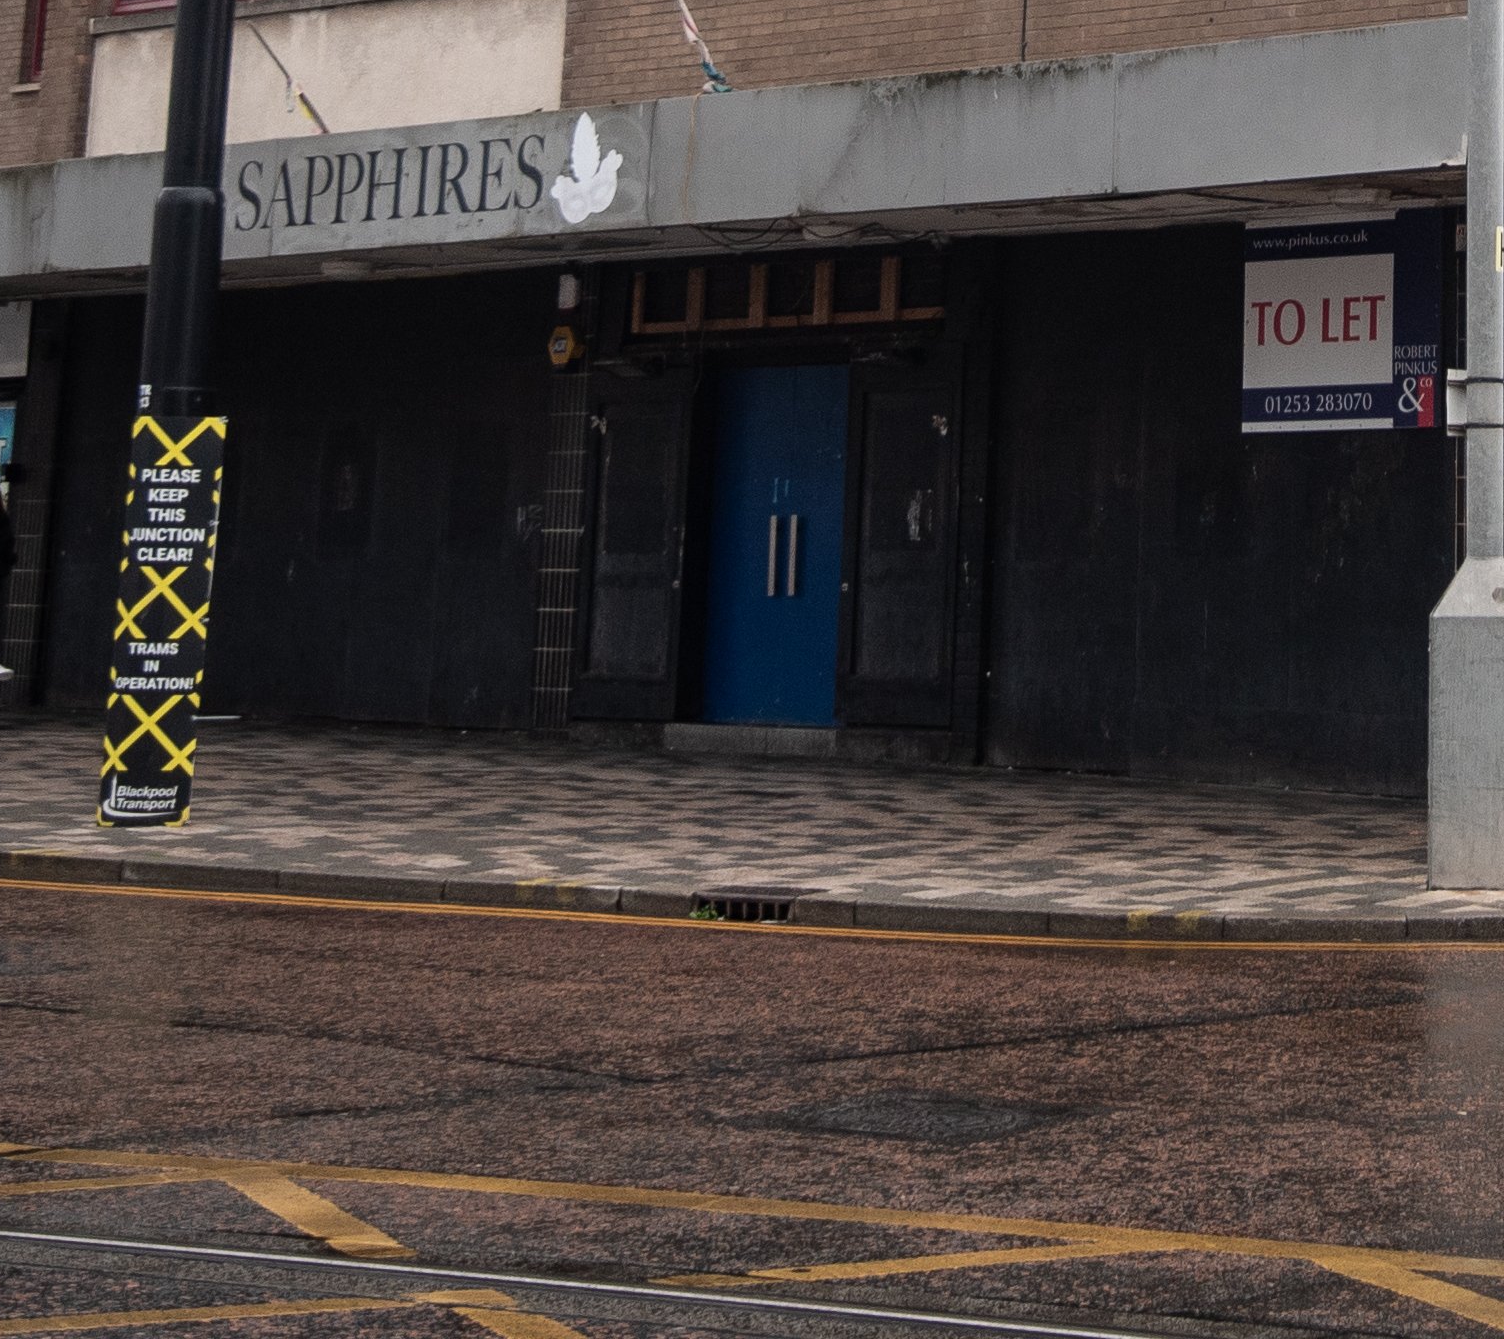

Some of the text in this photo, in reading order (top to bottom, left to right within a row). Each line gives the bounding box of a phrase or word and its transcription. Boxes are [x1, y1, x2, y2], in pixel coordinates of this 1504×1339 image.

[234, 134, 545, 231] SAPPHIRES
[1253, 229, 1369, 250] www.pinkus.co.uk
[1251, 295, 1385, 346] TO LET
[1395, 344, 1438, 359] ROBERT
[1395, 361, 1438, 375] PINKUS
[1398, 377, 1426, 413] &
[1265, 392, 1373, 414] 01253 283070
[141, 469, 201, 483] PLEASE
[148, 489, 189, 502] KEEP
[148, 508, 186, 522] THIS
[130, 528, 205, 542] JUNCTION
[137, 548, 193, 561] CLEAR!
[128, 642, 179, 655] TRAMS
[143, 660, 159, 672] IN
[116, 677, 194, 689] OPERATION!
[116, 786, 178, 799] Blackpool
[116, 798, 176, 810] Transport
